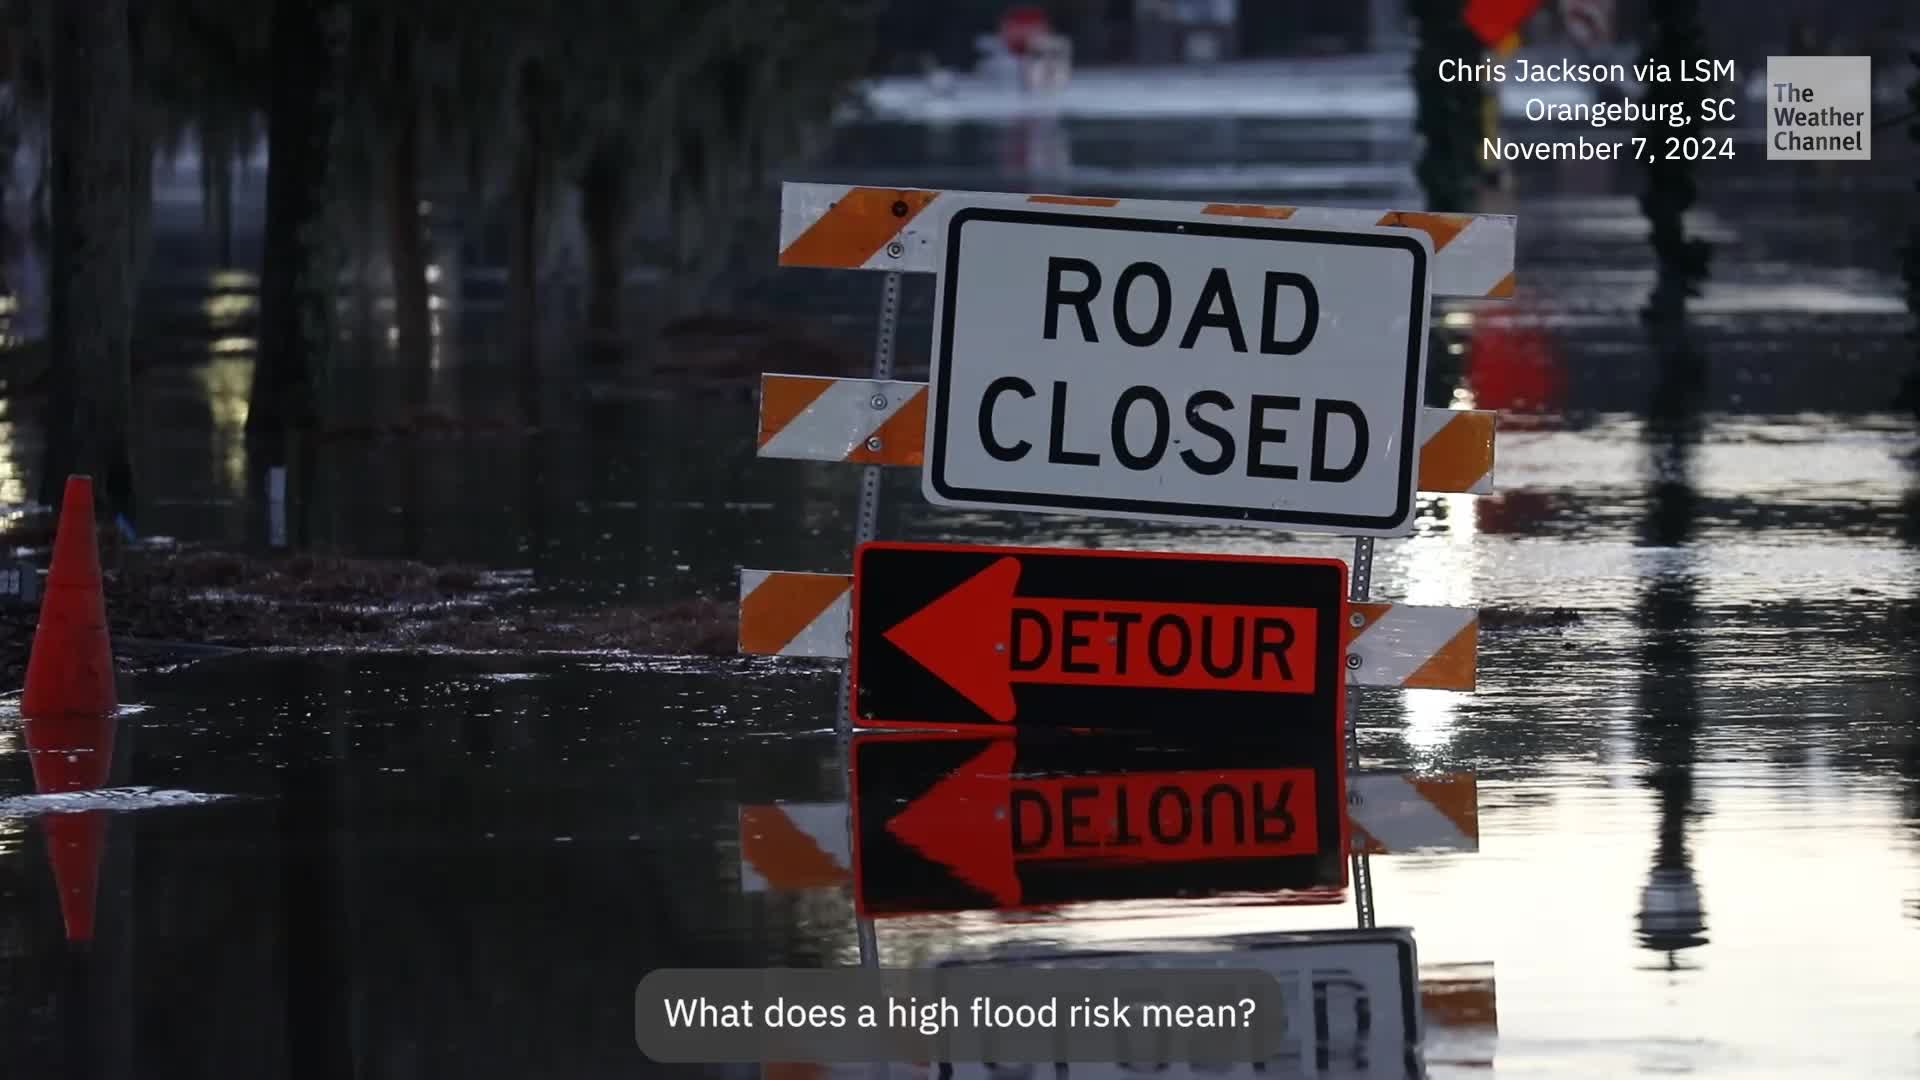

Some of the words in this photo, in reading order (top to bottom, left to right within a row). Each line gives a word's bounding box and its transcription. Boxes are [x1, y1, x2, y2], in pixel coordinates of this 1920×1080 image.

[1042, 255, 1320, 356] ROAD
[977, 375, 1370, 484] CLOSED
[1008, 606, 1296, 682] DETOUR
